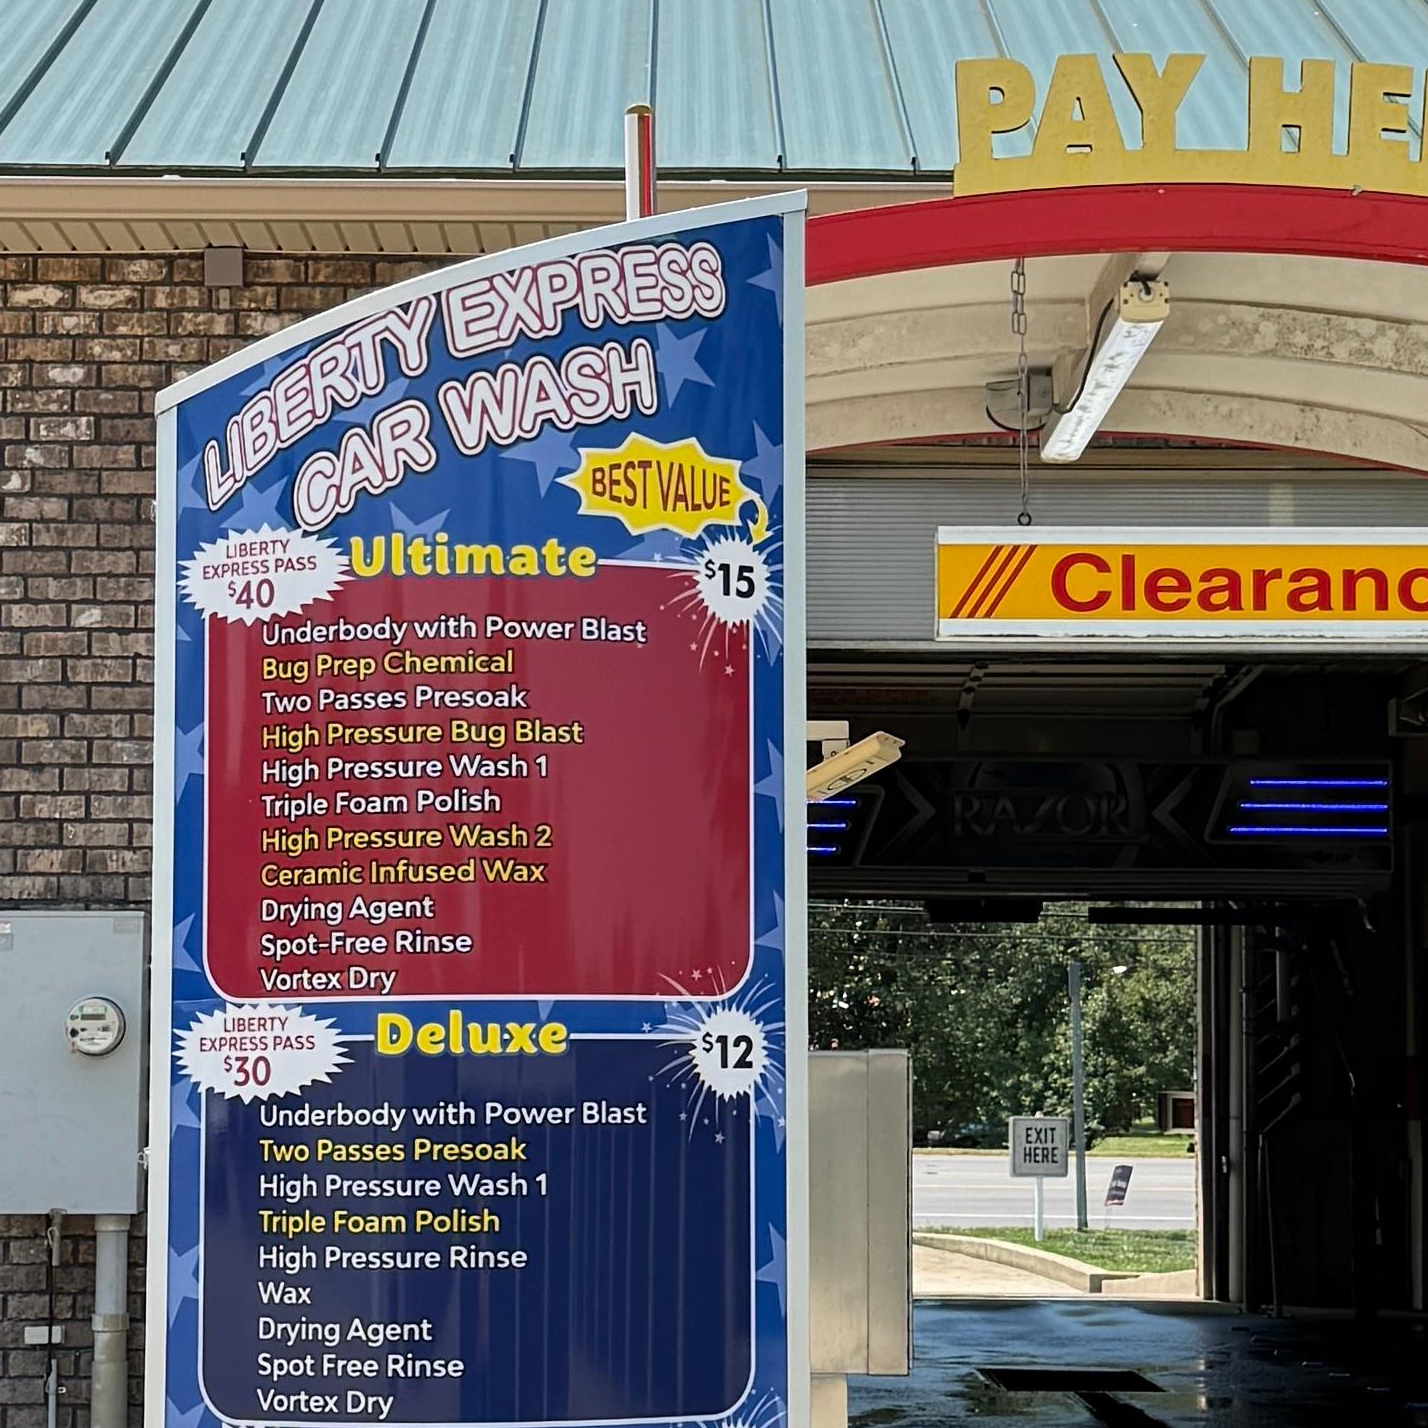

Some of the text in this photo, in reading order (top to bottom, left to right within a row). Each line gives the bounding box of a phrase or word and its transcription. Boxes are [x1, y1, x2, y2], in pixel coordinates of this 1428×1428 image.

[956, 53, 1204, 160] PAY
[204, 241, 724, 511] LIBERTY EXPRESS
[294, 340, 655, 530] CAR WASH
[591, 463, 731, 512] BEST VALUE
[225, 539, 290, 559] LIBERTY
[350, 535, 597, 579] Ultimate
[202, 556, 317, 580] EXPRESS PASS
[704, 558, 755, 600] $15
[228, 578, 274, 609] $40
[263, 616, 647, 646] Underbody with Power Blast
[262, 650, 513, 683] Bug Prep Chemical
[263, 685, 527, 713] Two Passes Presoak
[262, 720, 584, 752] High Pressure Bug Blast
[262, 756, 548, 785] High Pressure Wash 1
[262, 790, 501, 819] Triple Foam Polish
[950, 794, 1132, 837] RAZOR
[262, 825, 552, 855] High Pressure Wash 2
[262, 860, 546, 887] Ceramic Infused Wax
[261, 896, 434, 925] Drying Agent
[261, 931, 472, 959] Spot-Free Rinse
[261, 968, 396, 995] Vortex Dry
[223, 1017, 288, 1032] LIBERTY
[376, 1009, 568, 1057] Deluxe
[199, 1035, 315, 1051] EXPRESS PASS
[702, 1032, 754, 1069] $12
[224, 1056, 271, 1087] $30
[260, 1102, 647, 1132] Underbody with Power Blast
[260, 1138, 526, 1162] Two Passes Presoak
[1026, 1127, 1056, 1144] EXIT
[1024, 1147, 1058, 1163] HERE
[259, 1173, 548, 1202] High Pressure Wash 1
[259, 1209, 500, 1236] Triple Foam Polish
[259, 1245, 527, 1274] High Pressure Rinse
[258, 1283, 311, 1305] Wax
[258, 1318, 432, 1347] Drying Agent
[258, 1354, 464, 1381] Spot Free Rinse
[257, 1390, 393, 1418] Vortex Dry
